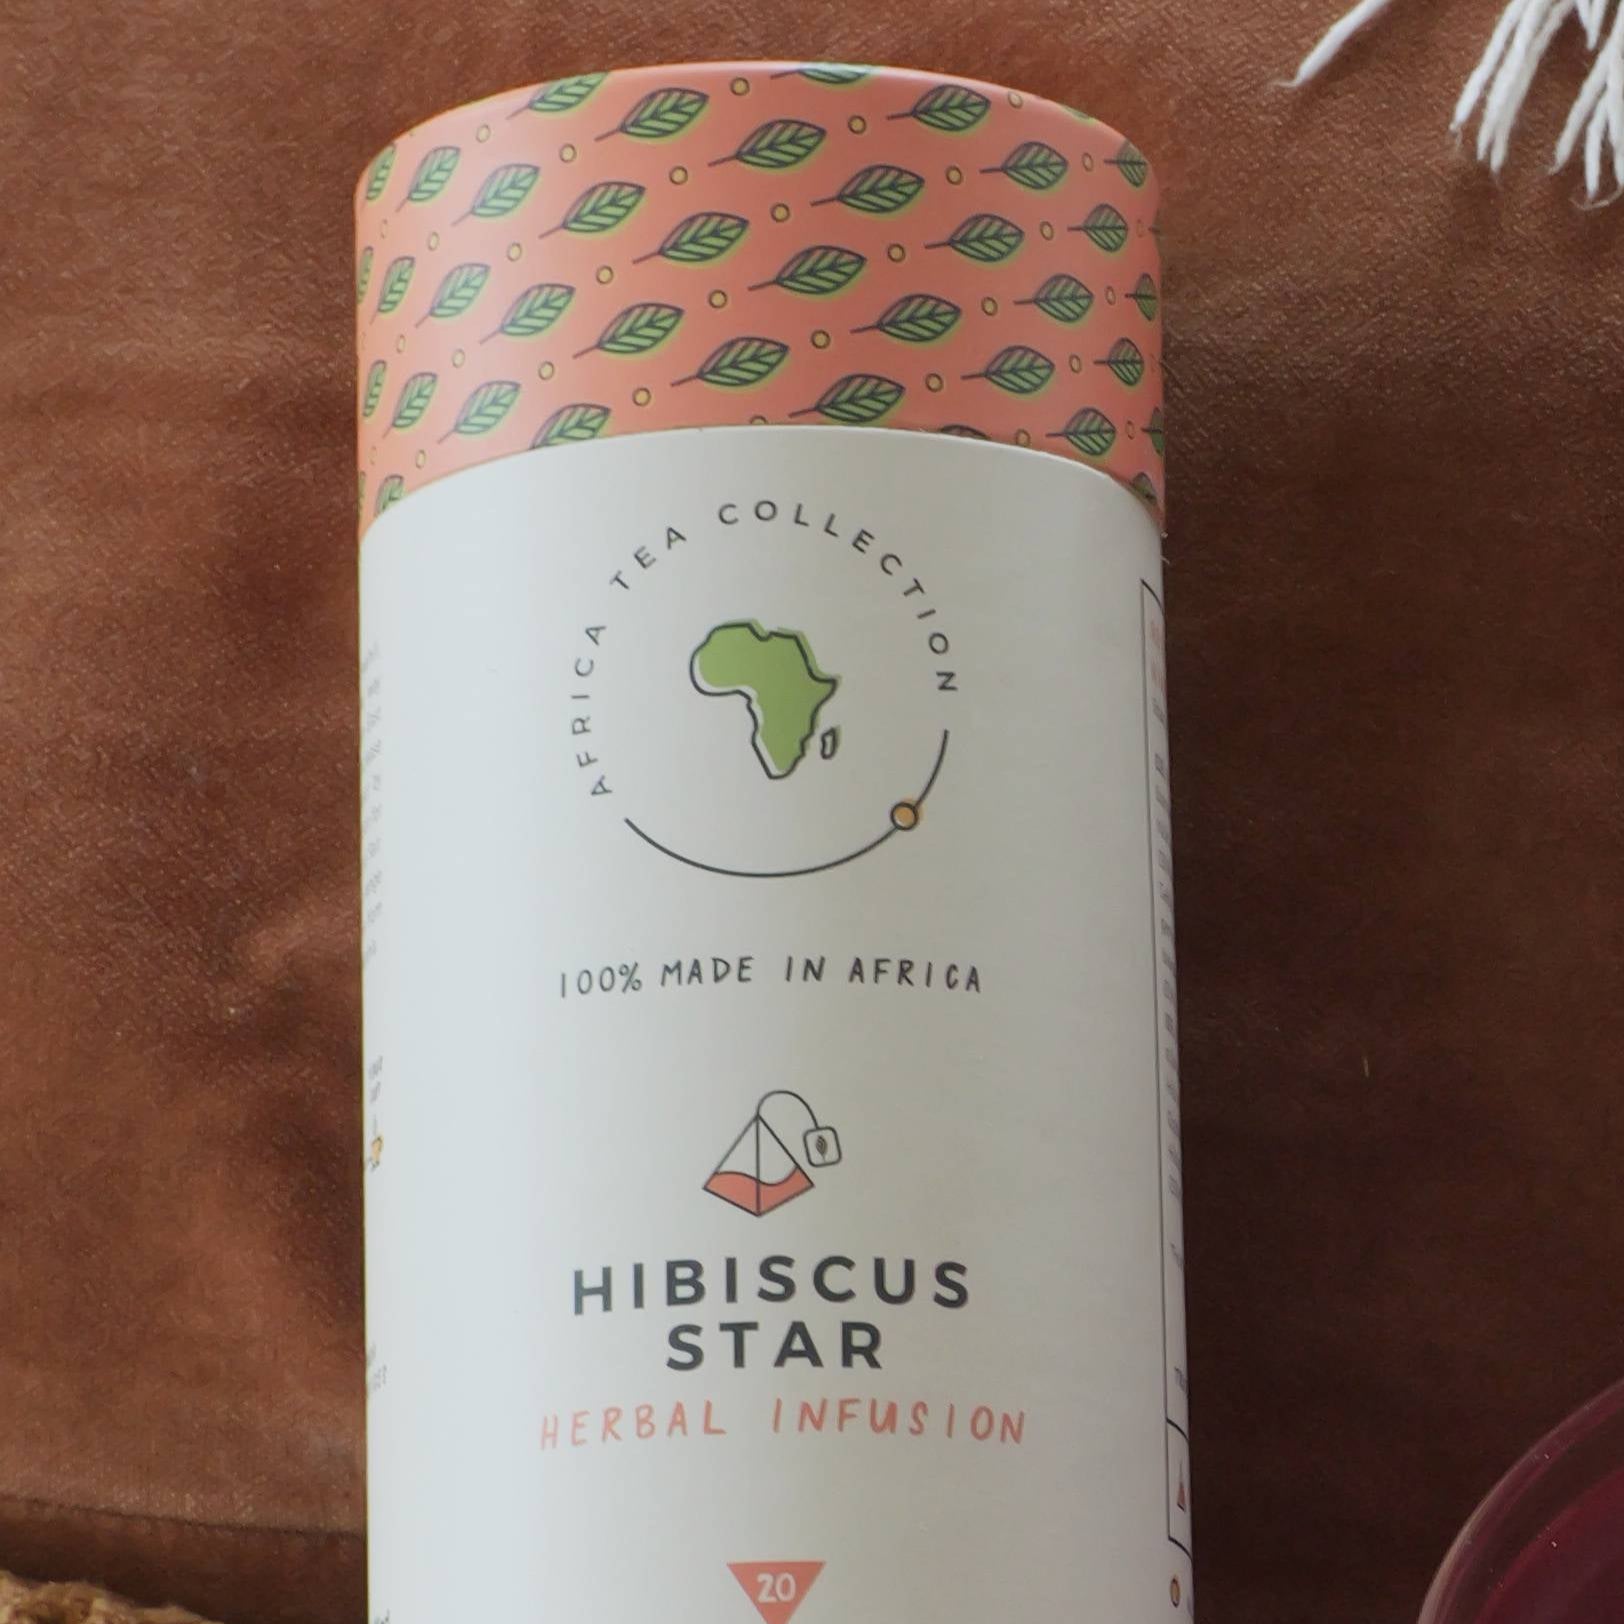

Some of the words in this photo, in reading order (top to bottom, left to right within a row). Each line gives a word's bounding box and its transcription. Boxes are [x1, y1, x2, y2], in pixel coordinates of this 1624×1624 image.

[570, 624, 613, 798] AFRICA
[609, 525, 688, 591] TEA
[717, 499, 959, 692] COLLECTION
[559, 960, 643, 999] 100%
[659, 955, 755, 989] MADE
[784, 954, 826, 984] IN
[847, 955, 982, 994] AFRICA
[572, 1254, 970, 1316] HIBISCUS
[665, 1319, 884, 1372] STAR
[541, 1400, 728, 1452] HERBAL
[772, 1398, 1026, 1445] INFUSION
[756, 1572, 798, 1603] 20
